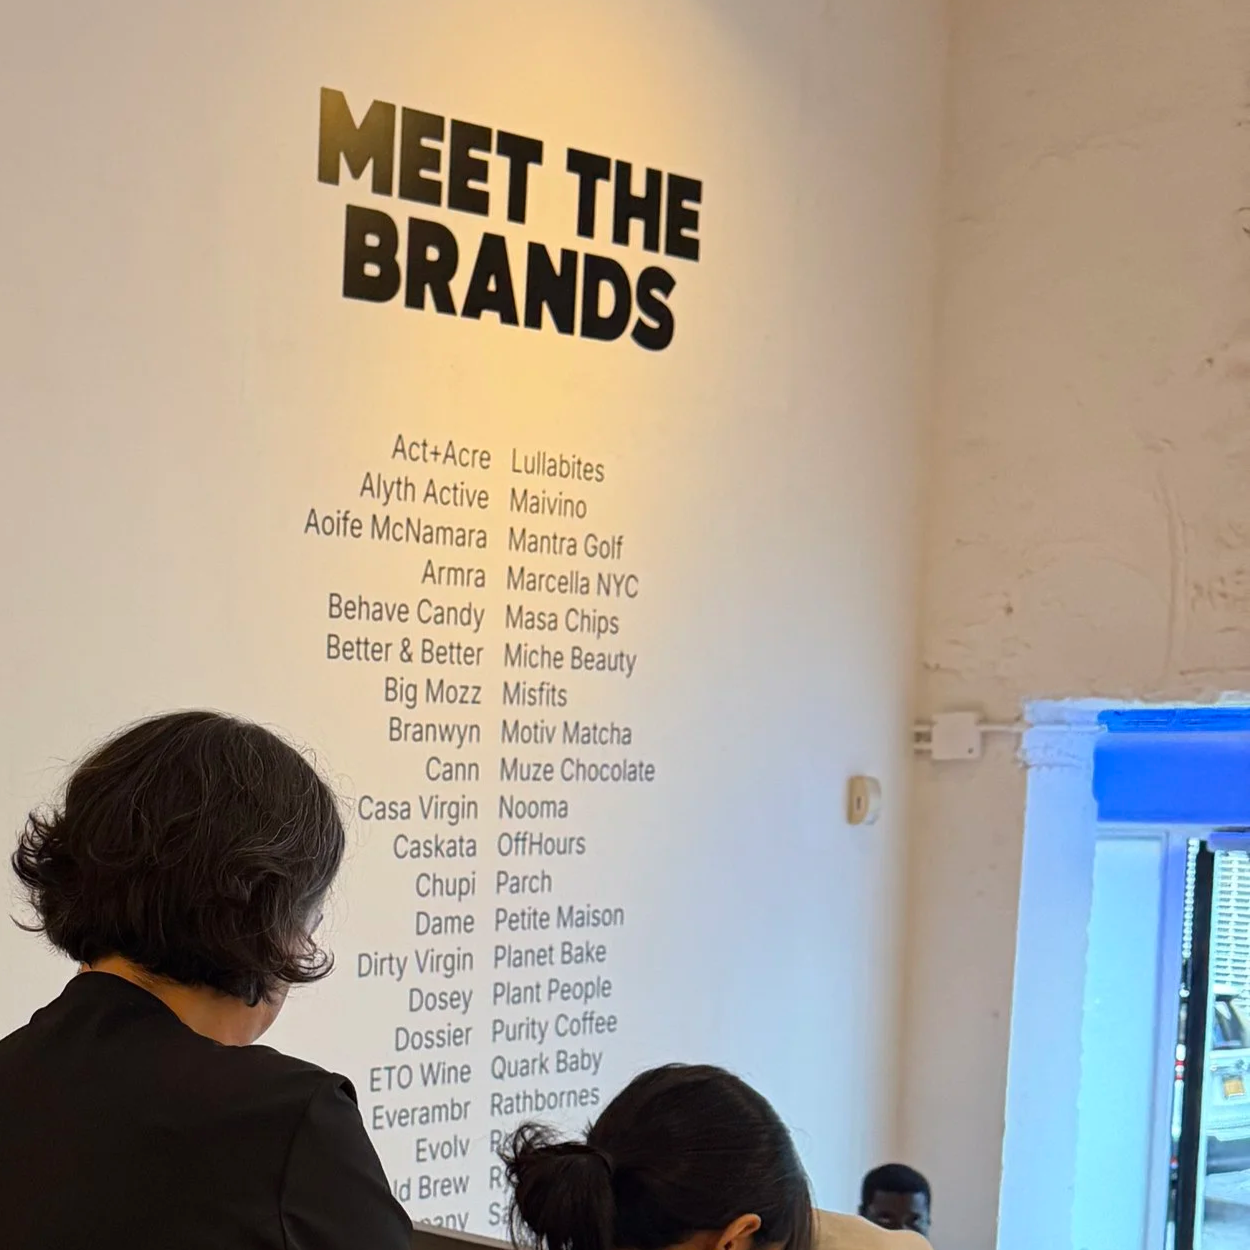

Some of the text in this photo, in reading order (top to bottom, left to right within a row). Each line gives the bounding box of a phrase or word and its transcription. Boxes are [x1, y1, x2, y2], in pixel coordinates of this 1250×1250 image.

[317, 86, 702, 262] MEET THE
[342, 204, 676, 352] BRANDS
[392, 434, 491, 469] Act+Acre
[512, 448, 604, 482] Lullabites
[360, 472, 489, 509] Alyth Active
[510, 487, 587, 519] Maivino
[304, 508, 486, 548] Aoife McNamara
[509, 527, 623, 559] Mantra Golf
[421, 559, 485, 588] Armra
[507, 566, 638, 598] Marcella NYC
[329, 593, 485, 633] Behave Candy
[506, 604, 619, 640] Masa Chips
[327, 634, 484, 665] Better & Better
[505, 643, 636, 678] Miche Beauty
[385, 677, 481, 709] Big Mozz
[503, 681, 567, 707] Misfits
[390, 717, 480, 749] Branwyn
[502, 719, 631, 745] Motiv Matcha
[426, 756, 479, 781] Cann
[501, 757, 655, 782] Muze Chocolate
[358, 794, 478, 826] Casa Virgin
[499, 795, 568, 819] Nooma
[394, 834, 476, 859] Caskata
[498, 831, 585, 856] OffHours
[416, 871, 475, 902] Chupi
[496, 870, 551, 894] Parch
[416, 911, 474, 935] Dame
[495, 904, 624, 931] Petite Maison
[358, 947, 473, 982] Dirty Virgin
[494, 941, 606, 968] Planet Bake
[409, 988, 473, 1015] Dosey
[493, 976, 612, 1005] Plant People
[395, 1022, 472, 1052] Dossier
[492, 1010, 617, 1045] Purity Coffee
[370, 1062, 471, 1092] ETO Wine
[491, 1048, 602, 1080] Quark Baby
[373, 1098, 471, 1130] Everambr
[491, 1087, 599, 1116] Rathbornes
[416, 1135, 469, 1162] Evolv
[419, 1175, 469, 1199] Brew
